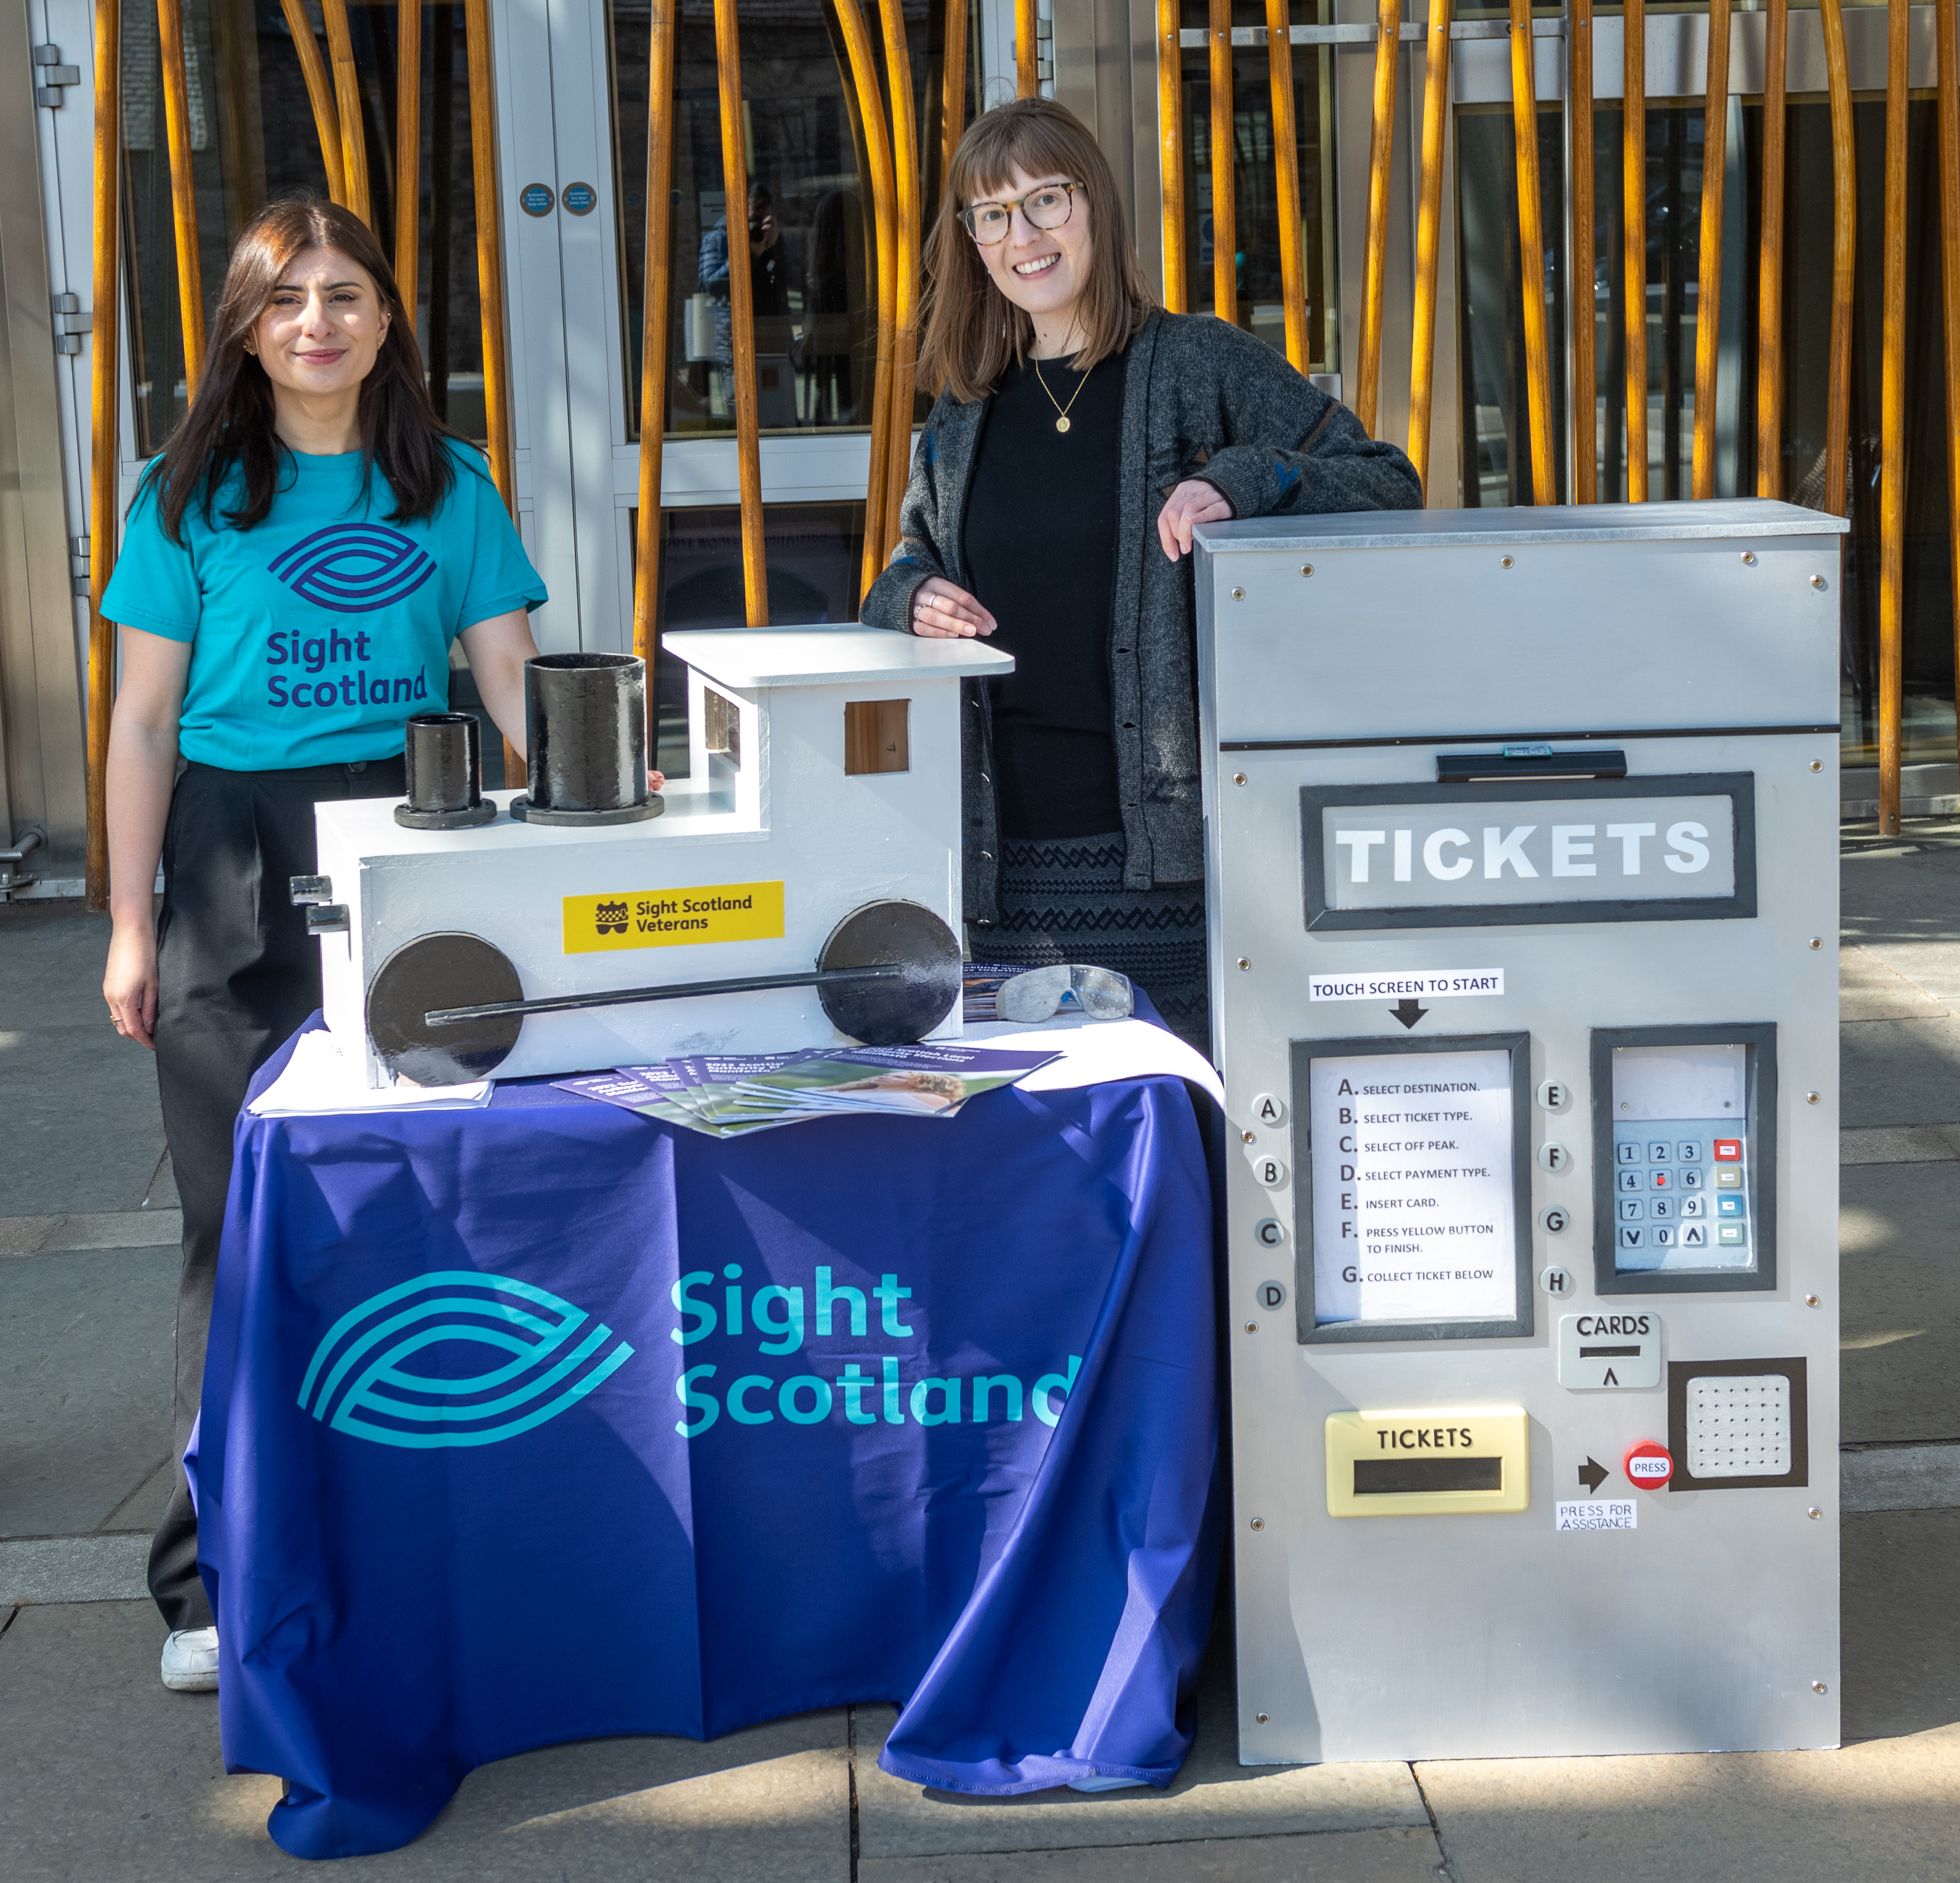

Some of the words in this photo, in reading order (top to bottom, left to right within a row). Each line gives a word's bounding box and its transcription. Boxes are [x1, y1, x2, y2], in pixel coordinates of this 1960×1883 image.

[267, 629, 371, 673] Sight
[268, 665, 427, 707] Scotland
[1336, 822, 1710, 882] TICKETS
[637, 901, 678, 918] Sight
[683, 895, 752, 913] Scotland
[637, 918, 708, 932] Veterans
[1314, 984, 1364, 996] TOUCH
[1370, 981, 1423, 994] SCREEN
[1429, 980, 1448, 991] TO
[1453, 978, 1498, 990] START
[1338, 1079, 1359, 1095] A.
[1364, 1085, 1400, 1094] SELECT
[1404, 1082, 1480, 1093] DESTINATION.
[1549, 1087, 1559, 1105] E
[1261, 1099, 1276, 1118] A
[1340, 1108, 1357, 1124] B.
[1364, 1114, 1401, 1123] SELECT
[1404, 1113, 1440, 1122] TICKET
[1443, 1112, 1472, 1121] TYPE.
[1340, 1136, 1357, 1153] C.
[1365, 1143, 1401, 1152] SELECT
[1405, 1142, 1424, 1150] OFF
[1428, 1141, 1458, 1150] PEAK.
[1626, 1147, 1632, 1159] 1
[1657, 1146, 1665, 1159] 2
[1686, 1146, 1694, 1158] 3
[1550, 1148, 1559, 1167] F
[1265, 1163, 1277, 1182] B
[1341, 1165, 1360, 1181] D.
[1365, 1171, 1402, 1180] SELECT
[1406, 1169, 1458, 1178] PAYMENT
[1462, 1168, 1490, 1177] TYPE.
[1687, 1172, 1695, 1185] 6
[1627, 1176, 1635, 1187] 4
[1341, 1193, 1357, 1210] E.
[1367, 1200, 1402, 1208] INSERT
[1406, 1198, 1439, 1207] CARD.
[1628, 1203, 1637, 1216] 7
[1658, 1202, 1666, 1215] 8
[1688, 1201, 1696, 1214] 9
[1342, 1222, 1357, 1238] F.
[1367, 1228, 1398, 1237] PRESS
[1402, 1227, 1445, 1236] YELLOW
[1449, 1225, 1493, 1234] BUTTON
[1547, 1212, 1563, 1231] G
[1261, 1223, 1277, 1244] C
[1660, 1230, 1668, 1242] 0
[1367, 1245, 1381, 1253] TO
[1385, 1243, 1423, 1253] FINISH.
[1342, 1266, 1363, 1283] G.
[1368, 1272, 1412, 1282] COLLECT
[1416, 1271, 1451, 1280] TICKET
[1455, 1270, 1493, 1279] BELOW
[1550, 1273, 1563, 1291] H
[1266, 1287, 1281, 1306] D
[670, 1263, 914, 1355] Sight
[1577, 1316, 1649, 1336] CARDS
[675, 1354, 1083, 1438] Scotland
[1377, 1429, 1472, 1449] TICKETS
[1635, 1463, 1666, 1472] PRESS
[1561, 1506, 1603, 1516] PRESS
[1610, 1505, 1631, 1515] FOR
[1562, 1517, 1632, 1530] ASSISTANCE
